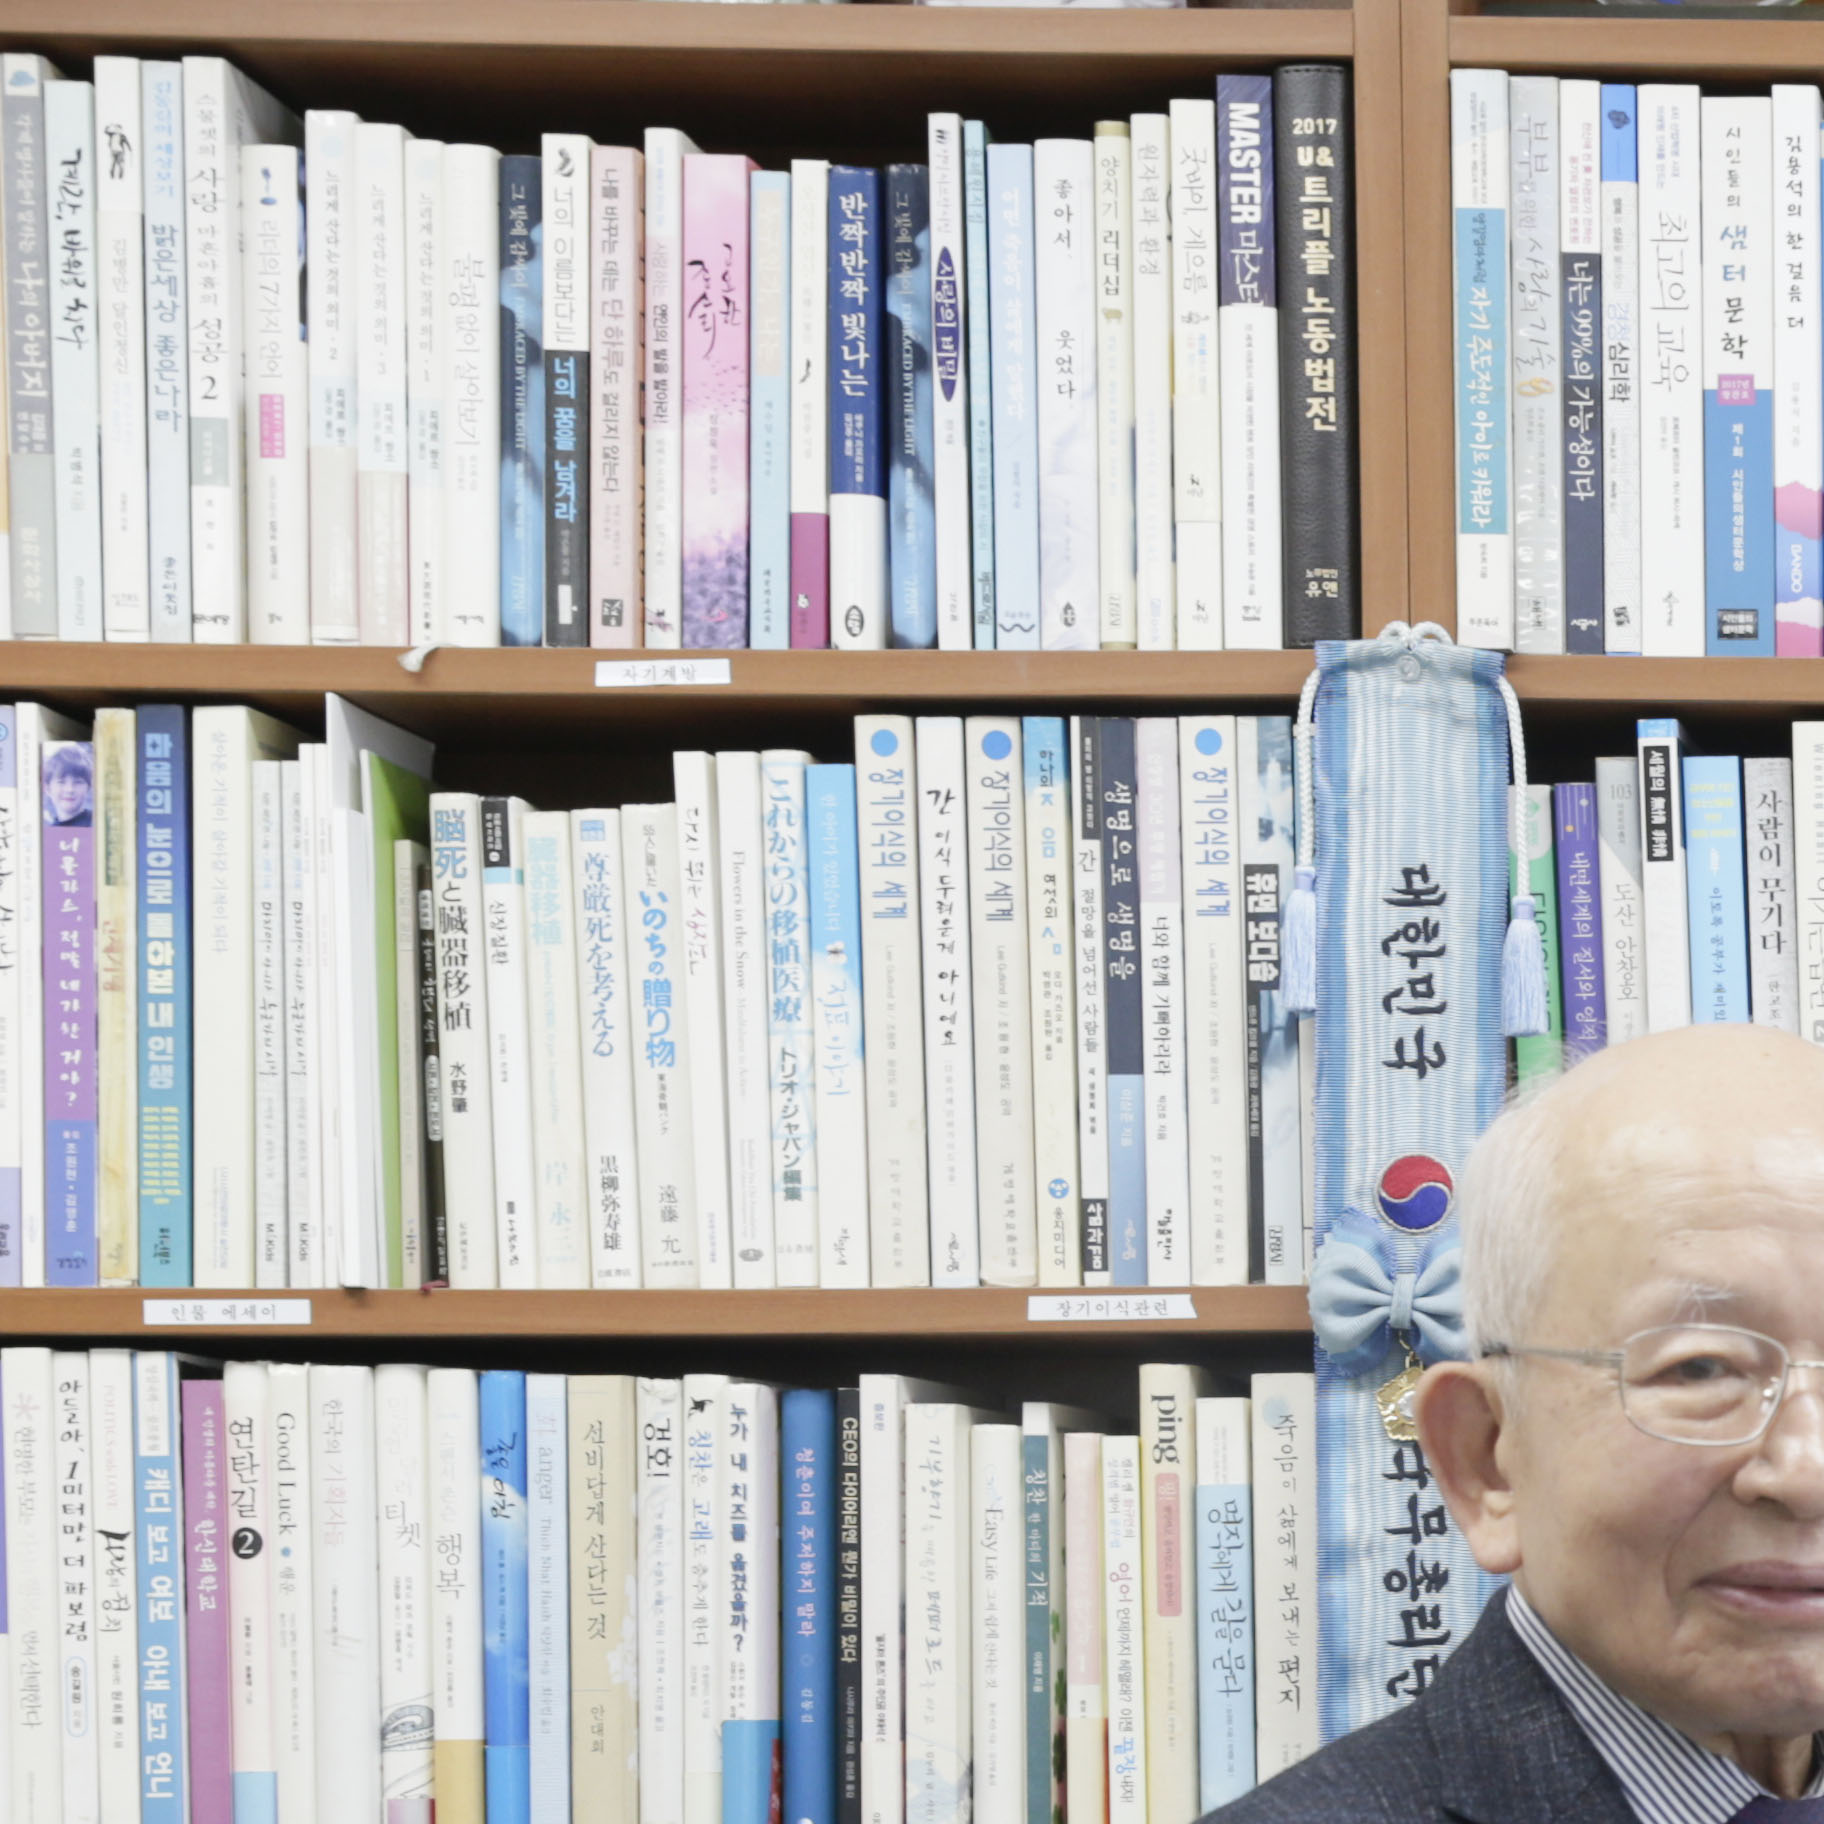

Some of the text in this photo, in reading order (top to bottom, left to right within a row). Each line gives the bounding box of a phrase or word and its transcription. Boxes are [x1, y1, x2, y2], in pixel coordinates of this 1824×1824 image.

[1228, 102, 1261, 226] MASTER
[1292, 118, 1337, 136] 2017
[1297, 147, 1335, 167] U&
[1299, 176, 1338, 433] 트리플 노동법전
[1305, 581, 1339, 600] 유앤
[434, 808, 472, 1030] 脳死と臓器移植
[766, 777, 803, 1023] これからの移植医療
[869, 769, 908, 919] 장기이식의 세계
[1104, 780, 1136, 980] 생명으로 생명을
[583, 852, 615, 1058] 尊厳死を考える
[638, 889, 677, 1069] いのちの贈り物
[1246, 872, 1280, 984] 휴먼 보디숍
[1382, 864, 1448, 1081] 대한민국
[1057, 1299, 1169, 1318] 장기이식관련
[275, 1412, 297, 1538] Good Luck
